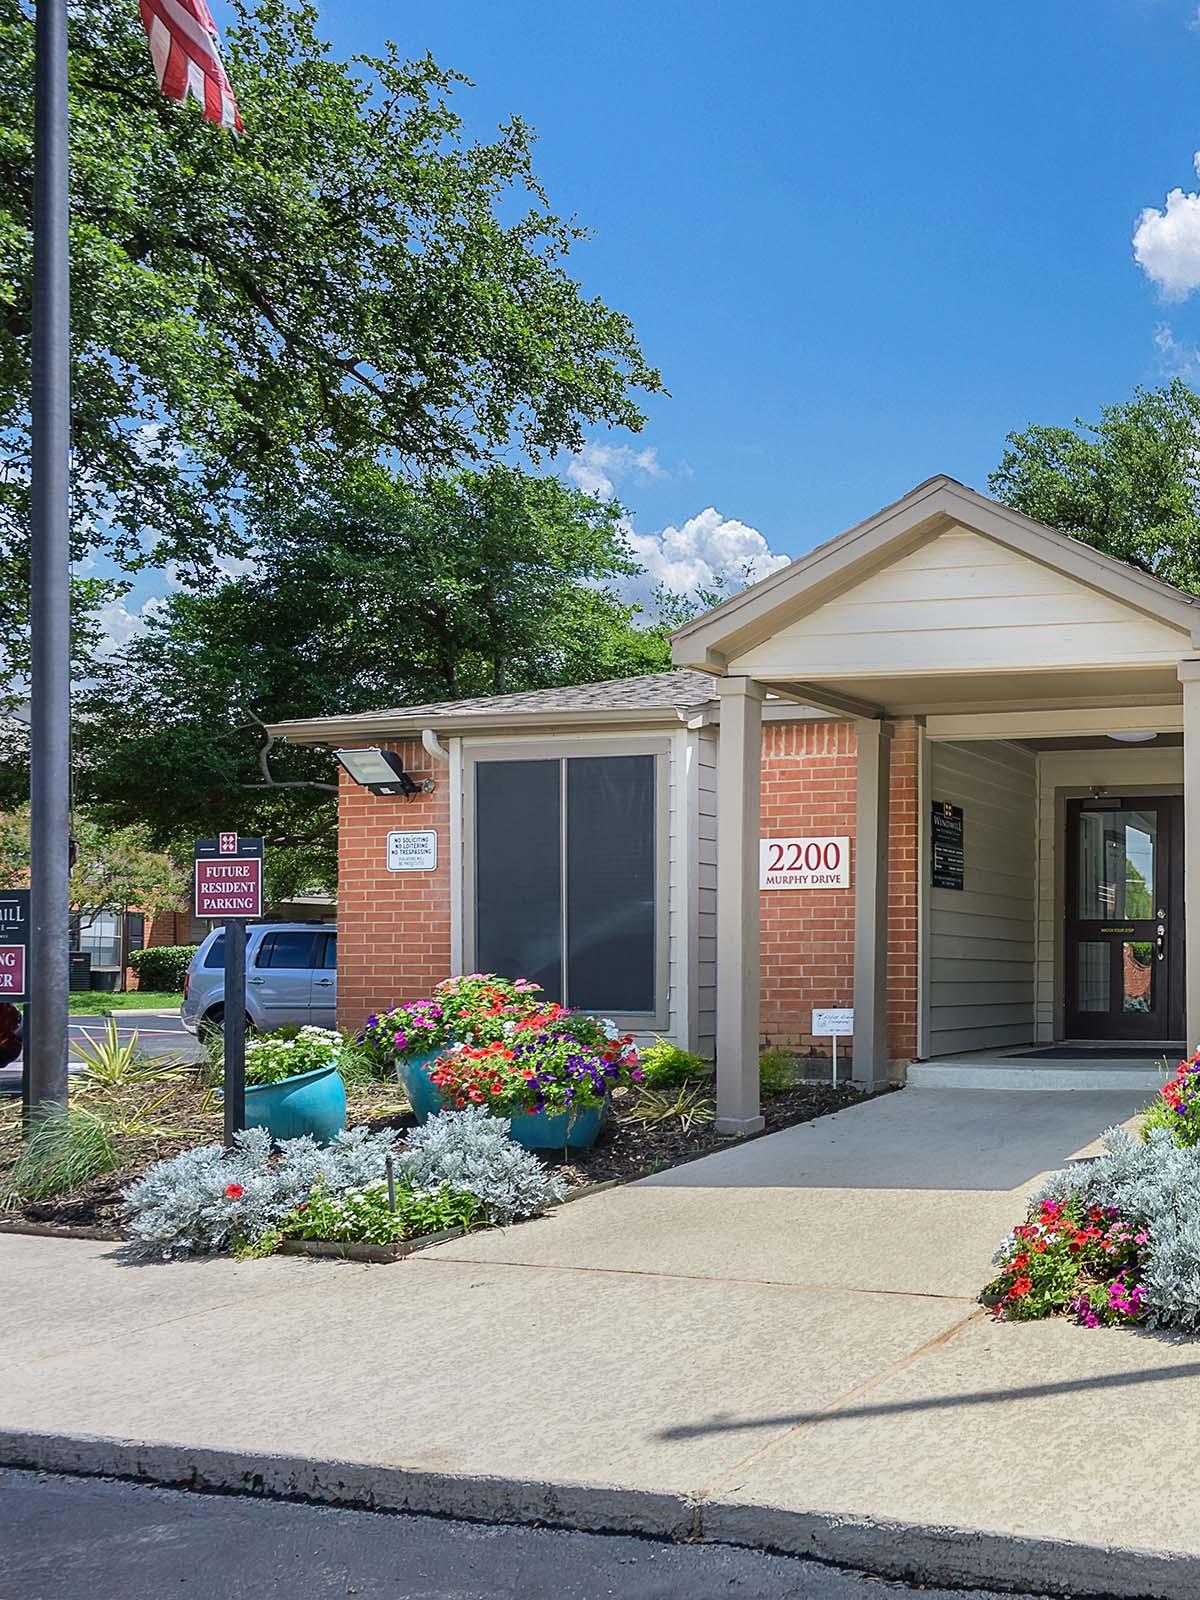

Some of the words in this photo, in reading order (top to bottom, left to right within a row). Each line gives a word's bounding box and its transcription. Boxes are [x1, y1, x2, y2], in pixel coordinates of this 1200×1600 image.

[767, 842, 841, 872] 2200
[206, 865, 251, 877] FUTURE
[766, 875, 809, 885] MURPHY
[810, 874, 841, 884] DRIVE
[201, 881, 256, 893] RESIDENT
[203, 897, 253, 909] PARKING
